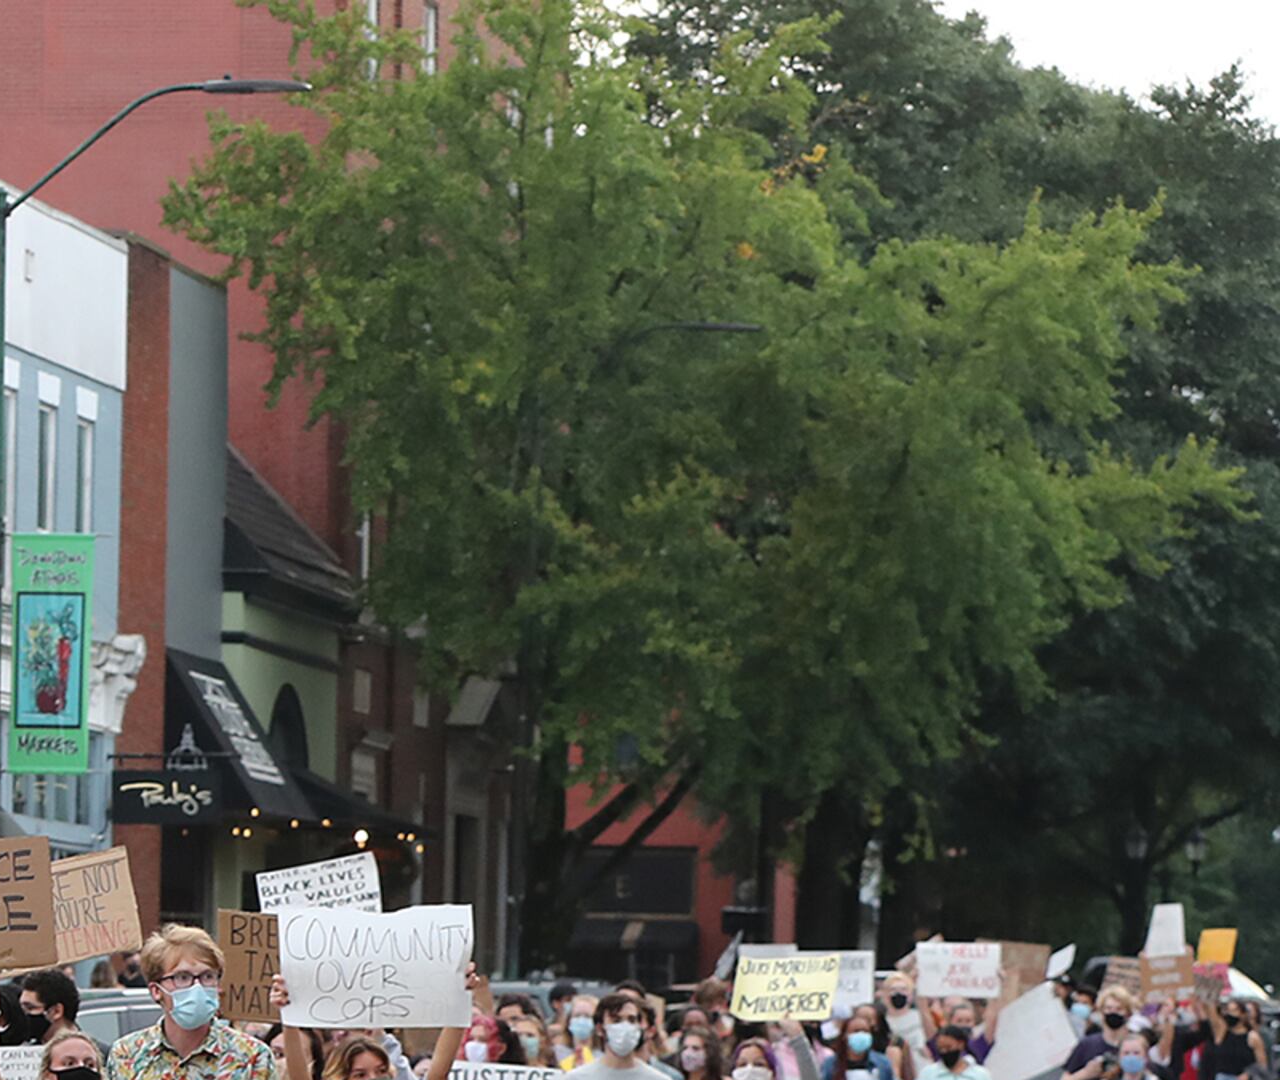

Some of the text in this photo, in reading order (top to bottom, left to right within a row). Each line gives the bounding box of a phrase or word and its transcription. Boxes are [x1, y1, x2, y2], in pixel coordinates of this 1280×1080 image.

[82, 860, 121, 896] NOT
[261, 866, 366, 898] BLACK LIVES
[305, 881, 366, 902] VALUED
[285, 913, 470, 974] COMMUNITY
[316, 960, 408, 993] OVER
[309, 995, 415, 1024] COPS
[738, 991, 830, 1015] MURDERER
